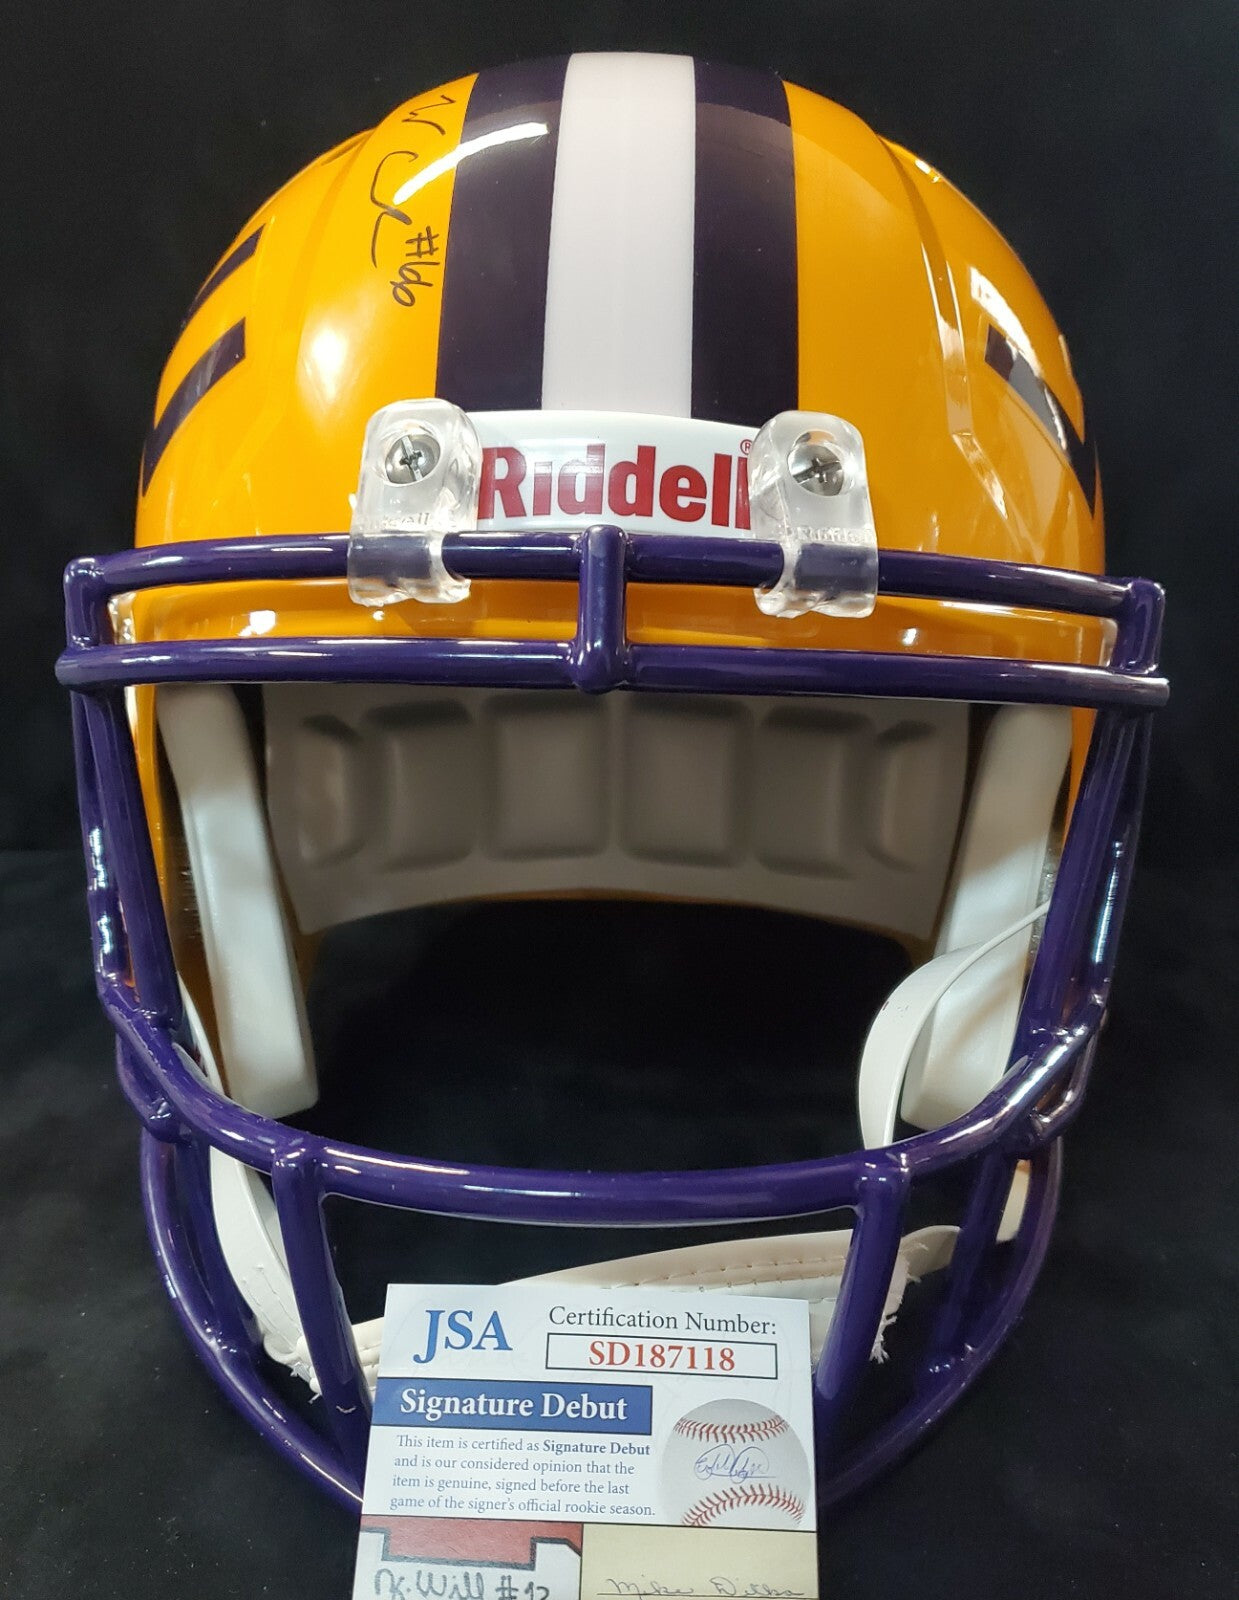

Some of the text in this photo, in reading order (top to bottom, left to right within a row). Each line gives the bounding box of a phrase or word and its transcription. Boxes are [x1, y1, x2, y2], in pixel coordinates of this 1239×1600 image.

[479, 445, 752, 531] Riddell
[549, 1305, 777, 1335] Certification Number:
[413, 1309, 513, 1364] JSA
[589, 1340, 735, 1371] SD187118
[400, 1388, 627, 1421] Signature Debut
[397, 1435, 650, 1456] This item is certified as Signature Debut
[394, 1455, 635, 1475] and is our considered opinion that the
[392, 1475, 629, 1495] item is genuine, signed before the last
[390, 1498, 424, 1510] game
[428, 1495, 441, 1509] of
[445, 1496, 464, 1509] the
[518, 1498, 561, 1512] official
[565, 1500, 606, 1514] rookie
[610, 1505, 655, 1516] season.
